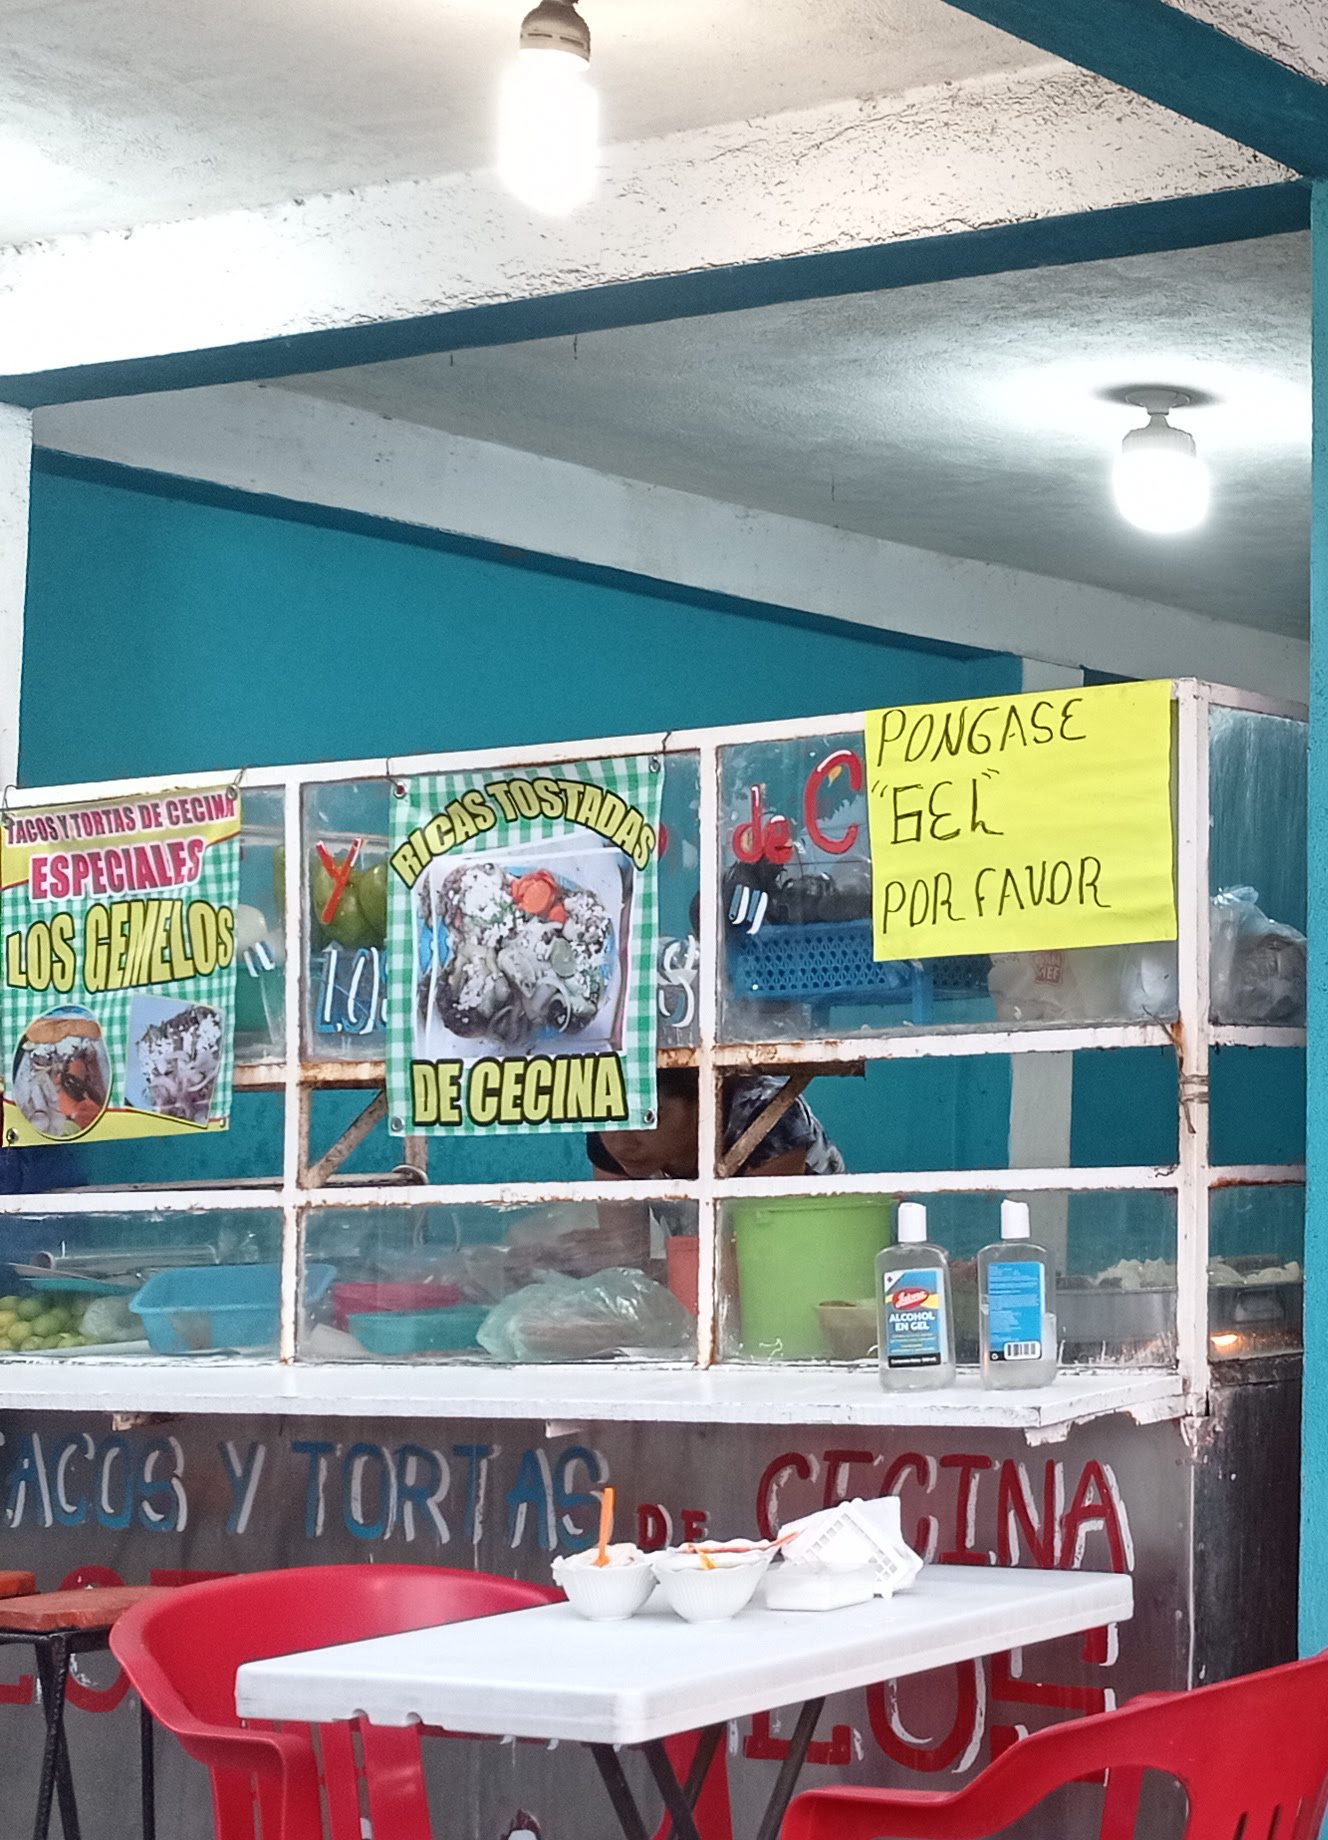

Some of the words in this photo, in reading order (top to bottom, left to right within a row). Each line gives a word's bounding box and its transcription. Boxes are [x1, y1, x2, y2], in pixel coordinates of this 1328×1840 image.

[877, 697, 1087, 767] PONGASE
[8, 815, 58, 844] TACOS
[56, 814, 70, 839] Y
[70, 805, 136, 837] TORTAS
[137, 802, 162, 829] DE
[166, 794, 235, 826] CECINA
[390, 791, 497, 888] RICAS
[488, 777, 656, 870] TOSTADAS
[732, 784, 794, 864] de
[31, 839, 204, 899] ESPECIALES
[315, 837, 367, 923] Y
[883, 872, 966, 934] POR
[974, 856, 1112, 918] FAVOR
[6, 911, 76, 993] LOS
[83, 898, 235, 994] GEMELOS
[410, 1059, 463, 1126] DE
[466, 1051, 629, 1124] CECINA
[889, 1311, 936, 1323] ALCOHOL
[895, 1322, 909, 1332] EN
[911, 1320, 930, 1331] GEL
[0, 1431, 188, 1532] ACOS
[219, 1440, 267, 1536] Y
[292, 1440, 610, 1553] TORTAS
[638, 1503, 710, 1550] DE
